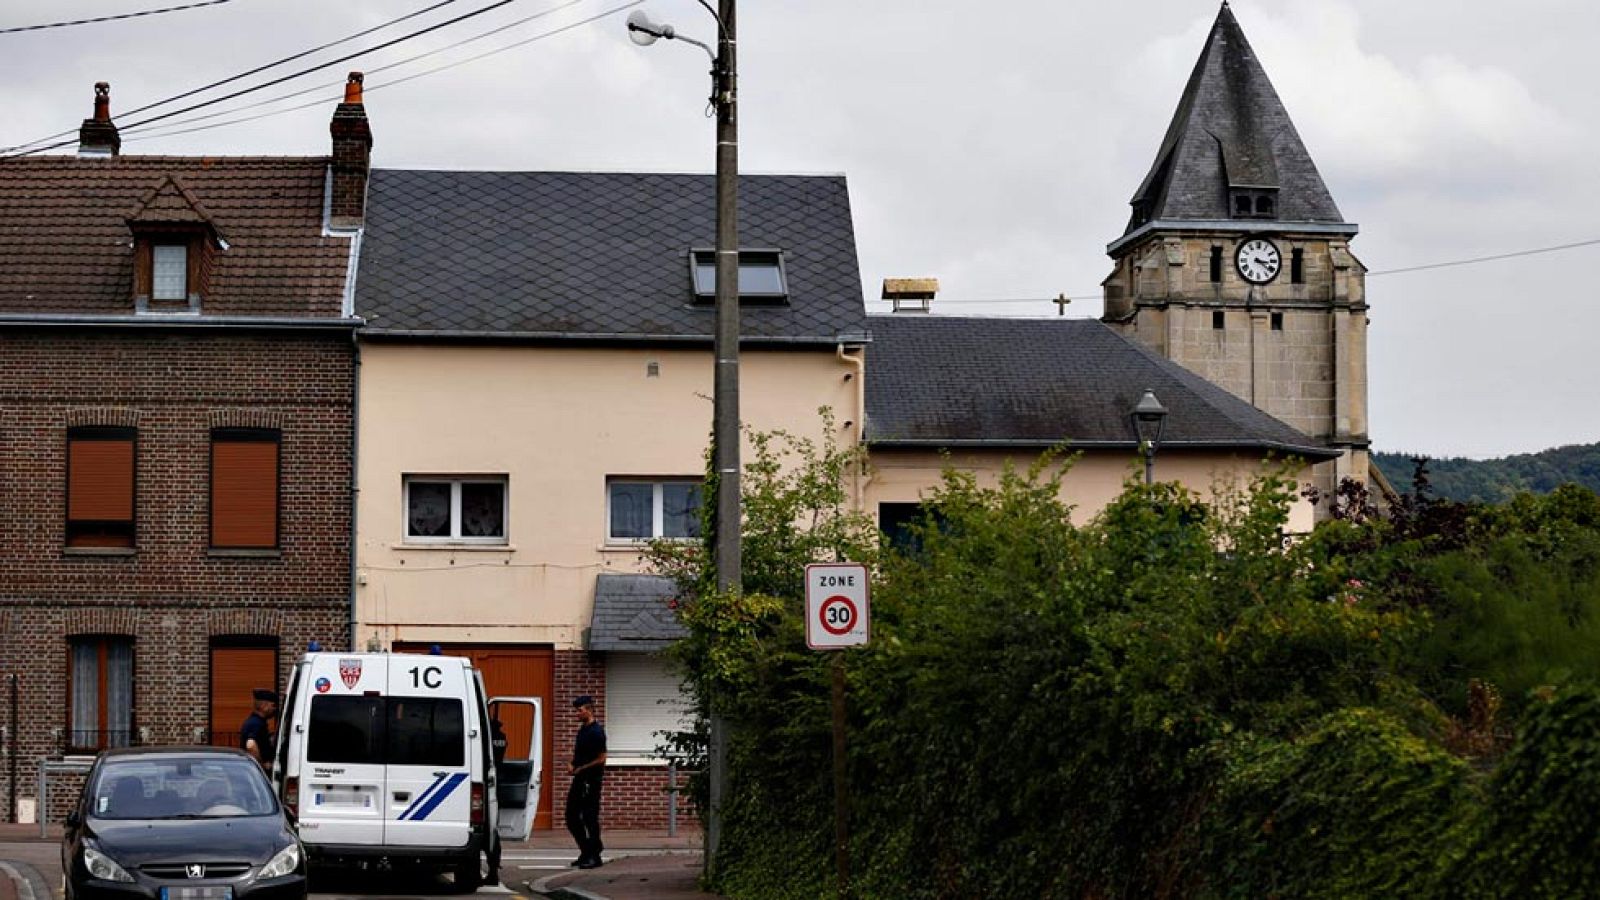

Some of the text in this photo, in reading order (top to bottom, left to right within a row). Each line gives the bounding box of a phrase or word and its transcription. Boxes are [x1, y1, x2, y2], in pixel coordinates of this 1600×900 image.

[820, 576, 855, 587] ZONE
[827, 607, 850, 624] 30
[408, 666, 442, 689] 1C
